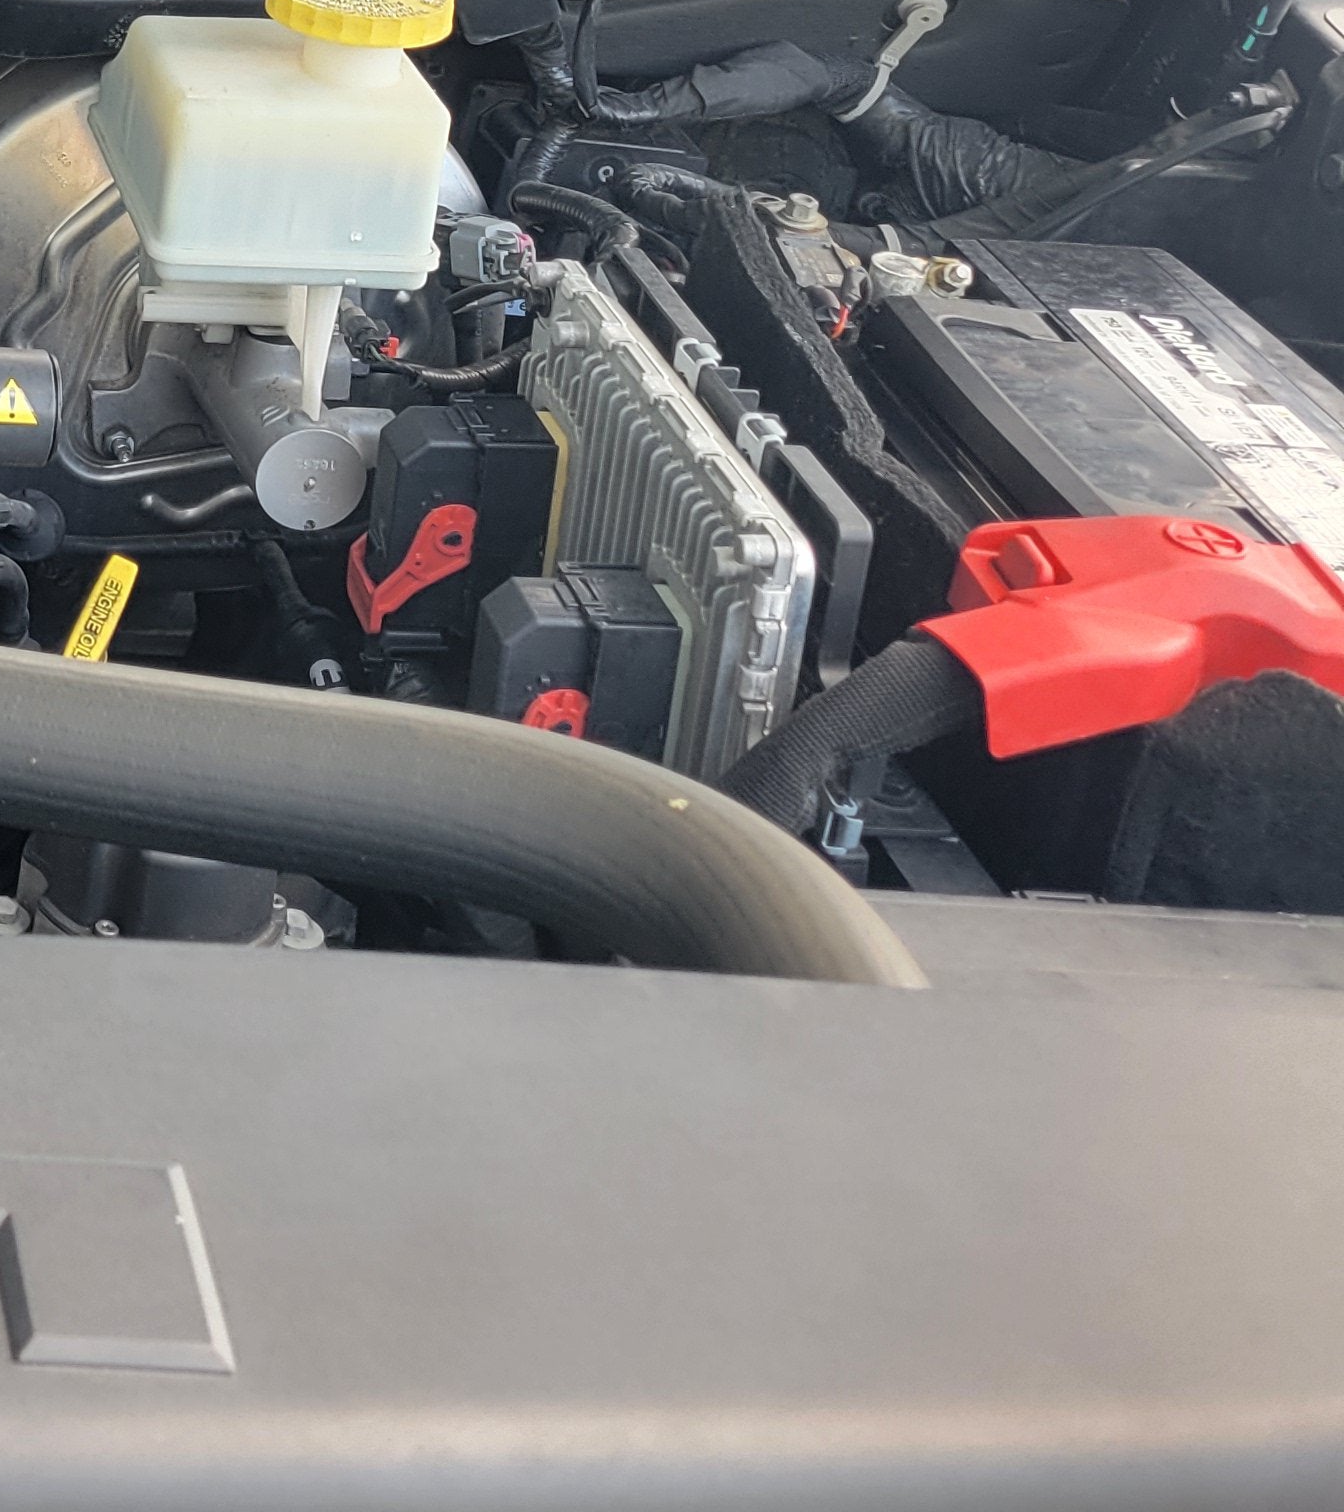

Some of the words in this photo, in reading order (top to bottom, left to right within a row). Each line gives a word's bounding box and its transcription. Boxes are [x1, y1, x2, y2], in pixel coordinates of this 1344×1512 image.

[1139, 314, 1248, 388] DieHard
[85, 577, 123, 635] ENGINE
[73, 632, 97, 659] OIL
